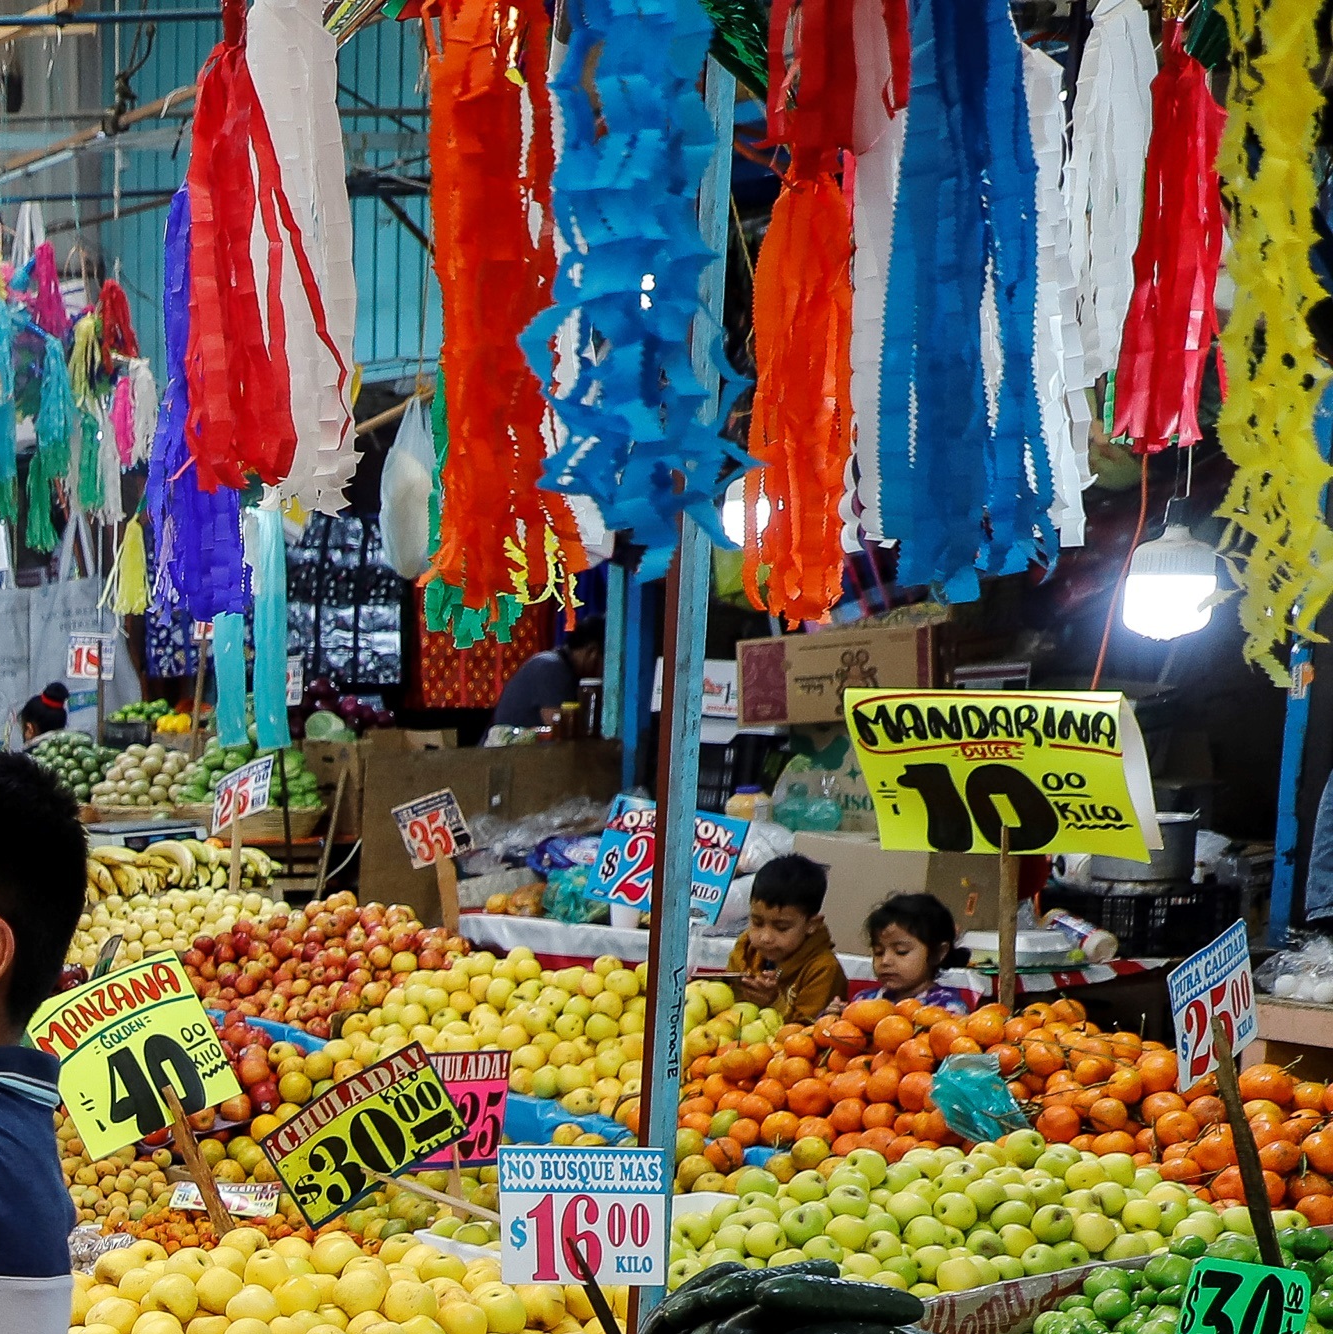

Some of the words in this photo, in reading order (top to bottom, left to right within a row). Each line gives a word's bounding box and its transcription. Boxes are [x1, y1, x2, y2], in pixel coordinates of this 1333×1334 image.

[853, 704, 1117, 748] MANDARINA
[1053, 800, 1123, 824] KILO
[699, 848, 729, 876] 00
[691, 883, 721, 901] KILO
[1174, 968, 1201, 999] PURA
[1203, 932, 1245, 980] CALIDAD
[1231, 970, 1251, 1020] 00
[36, 963, 181, 1060] MANZANA
[100, 1020, 147, 1050] GOLDEN
[1236, 1015, 1253, 1042] KILO
[193, 1042, 223, 1070] KILO
[379, 1070, 419, 1106] KILO
[265, 1046, 426, 1162] ¡CHULADA!
[507, 1160, 535, 1180] NO
[539, 1160, 615, 1185] BUSQUE
[619, 1161, 659, 1182] MAS
[509, 1194, 603, 1281] $16
[607, 1202, 651, 1248] 00
[615, 1256, 653, 1274] KILO
